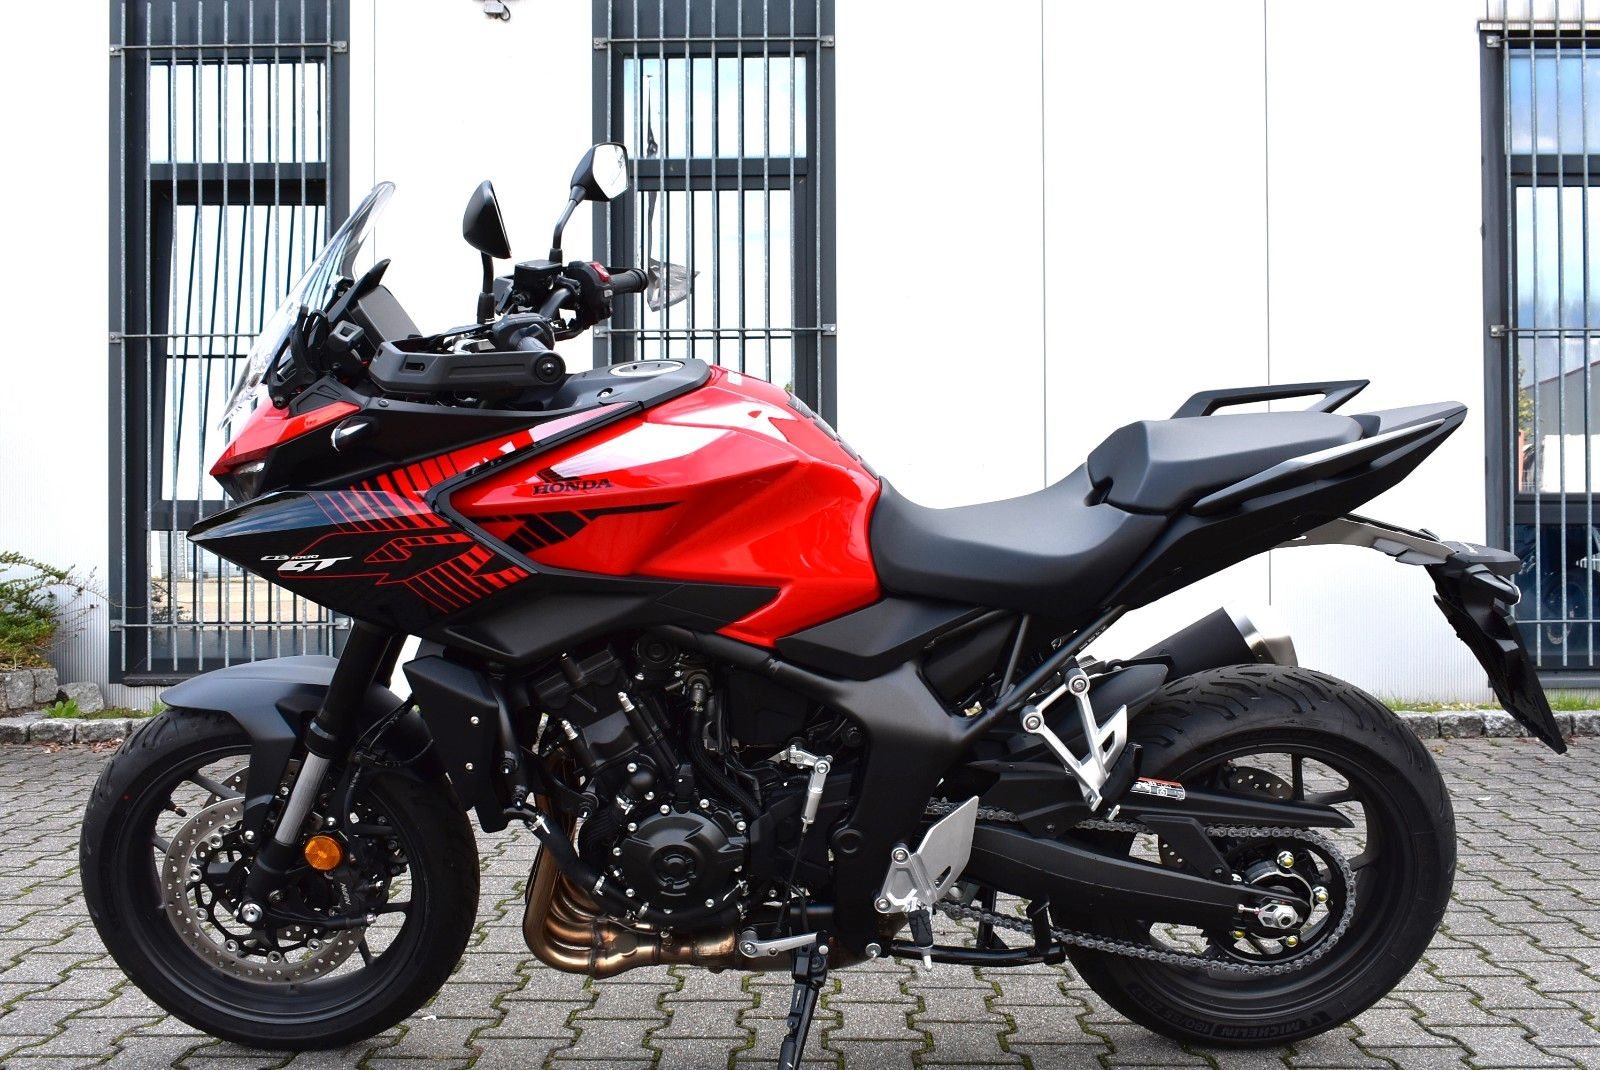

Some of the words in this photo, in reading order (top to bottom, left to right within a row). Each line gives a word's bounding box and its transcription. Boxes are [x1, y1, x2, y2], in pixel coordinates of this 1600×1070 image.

[533, 478, 613, 495] HONDA
[276, 556, 352, 573] GT
[1220, 1021, 1300, 1039] MICHELIN
